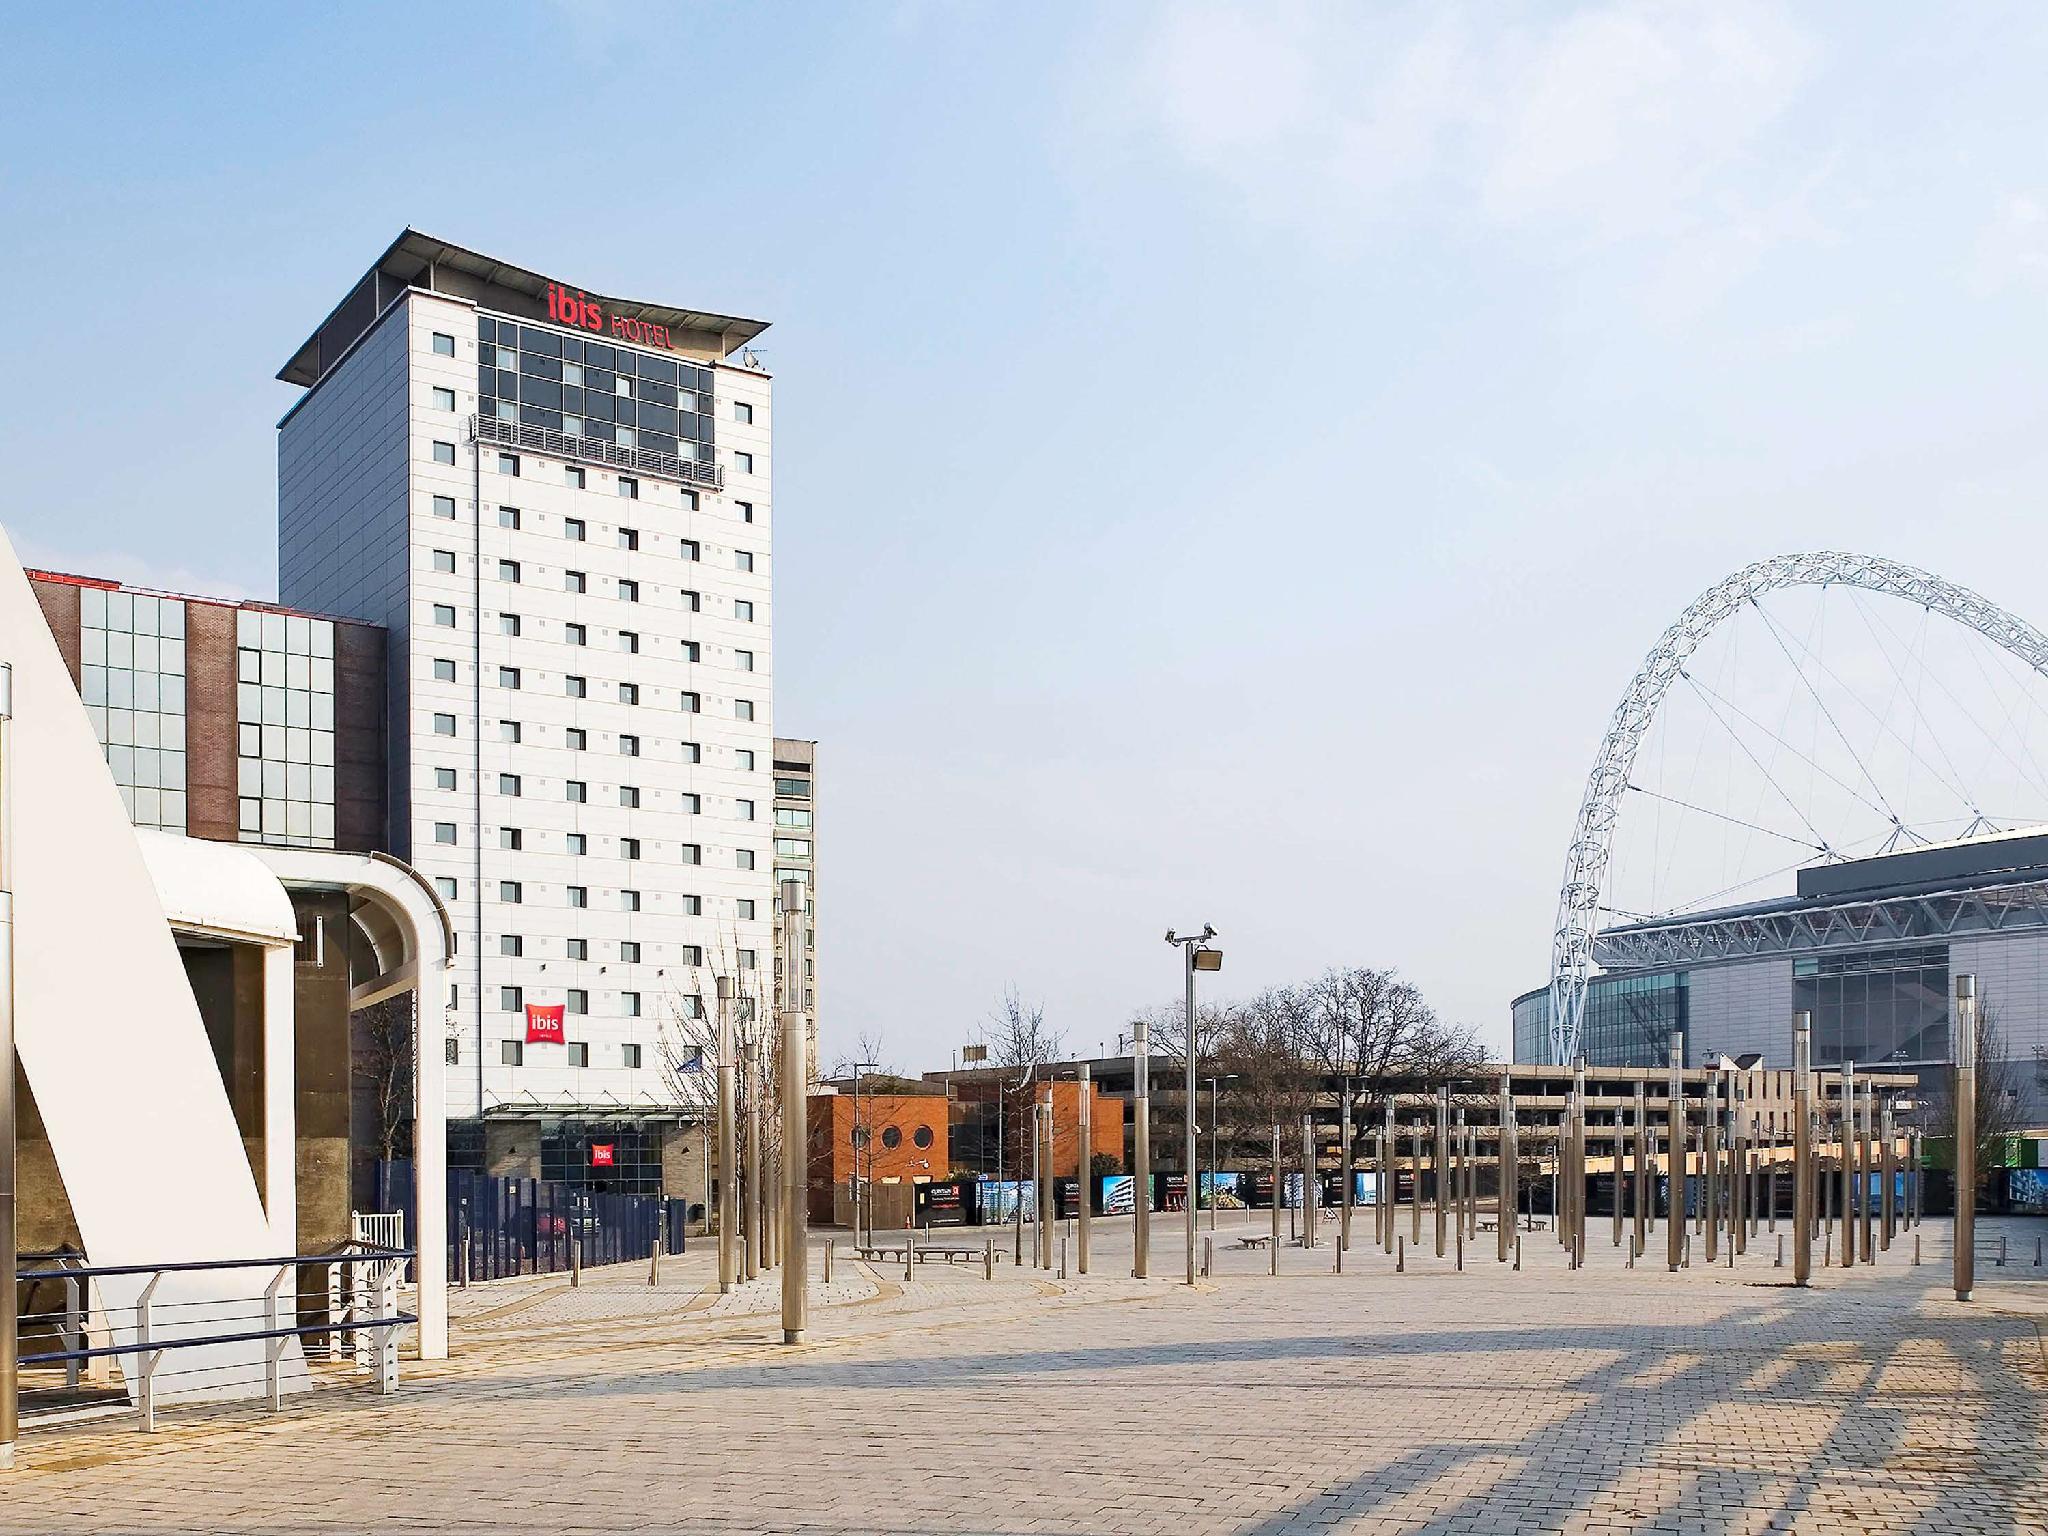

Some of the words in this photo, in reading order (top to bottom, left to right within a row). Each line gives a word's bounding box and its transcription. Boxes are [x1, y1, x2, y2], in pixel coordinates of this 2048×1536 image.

[548, 282, 602, 331] ibis
[610, 312, 676, 350] HOTEL
[532, 1014, 559, 1030] ibis
[595, 1149, 611, 1159] ibis
